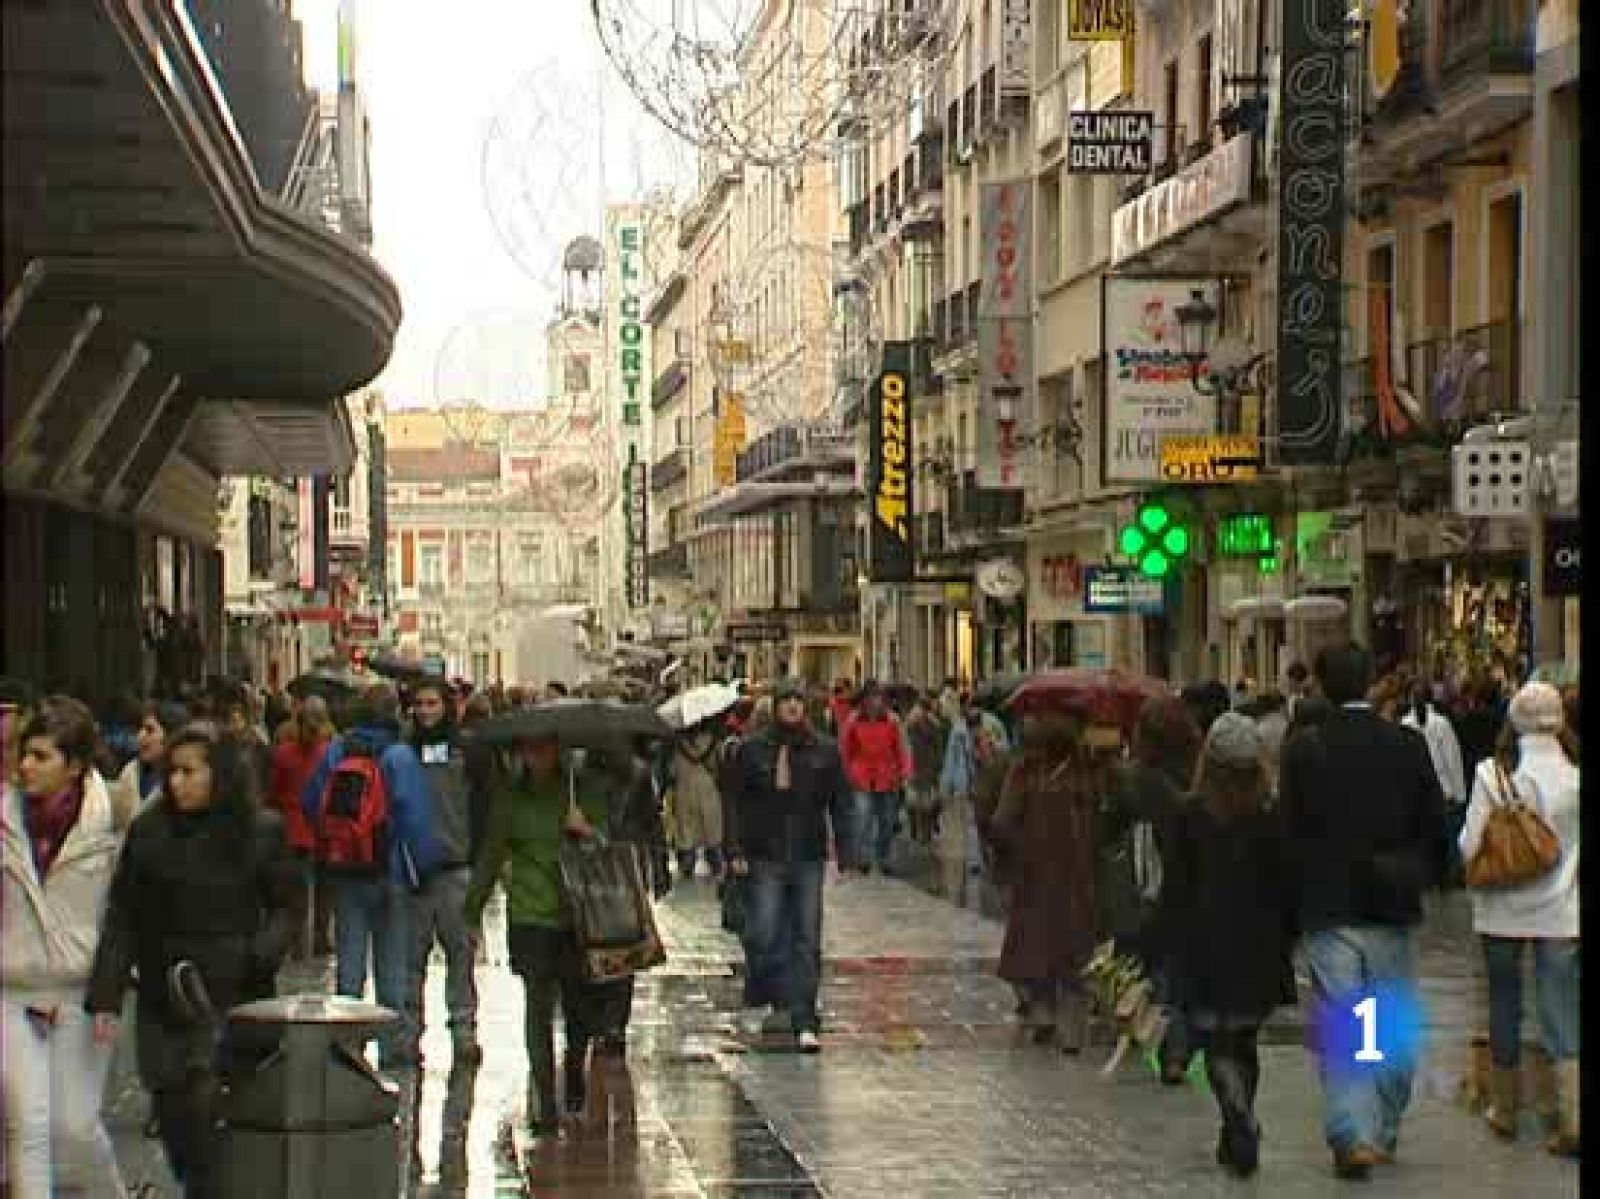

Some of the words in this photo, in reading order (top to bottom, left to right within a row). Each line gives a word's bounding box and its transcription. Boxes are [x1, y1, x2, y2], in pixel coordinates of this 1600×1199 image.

[1071, 115, 1151, 140] CLINICA
[1072, 144, 1150, 167] DENTAL
[619, 227, 638, 279] EL
[619, 297, 640, 425] CORTE
[875, 373, 907, 542] Atrezzo
